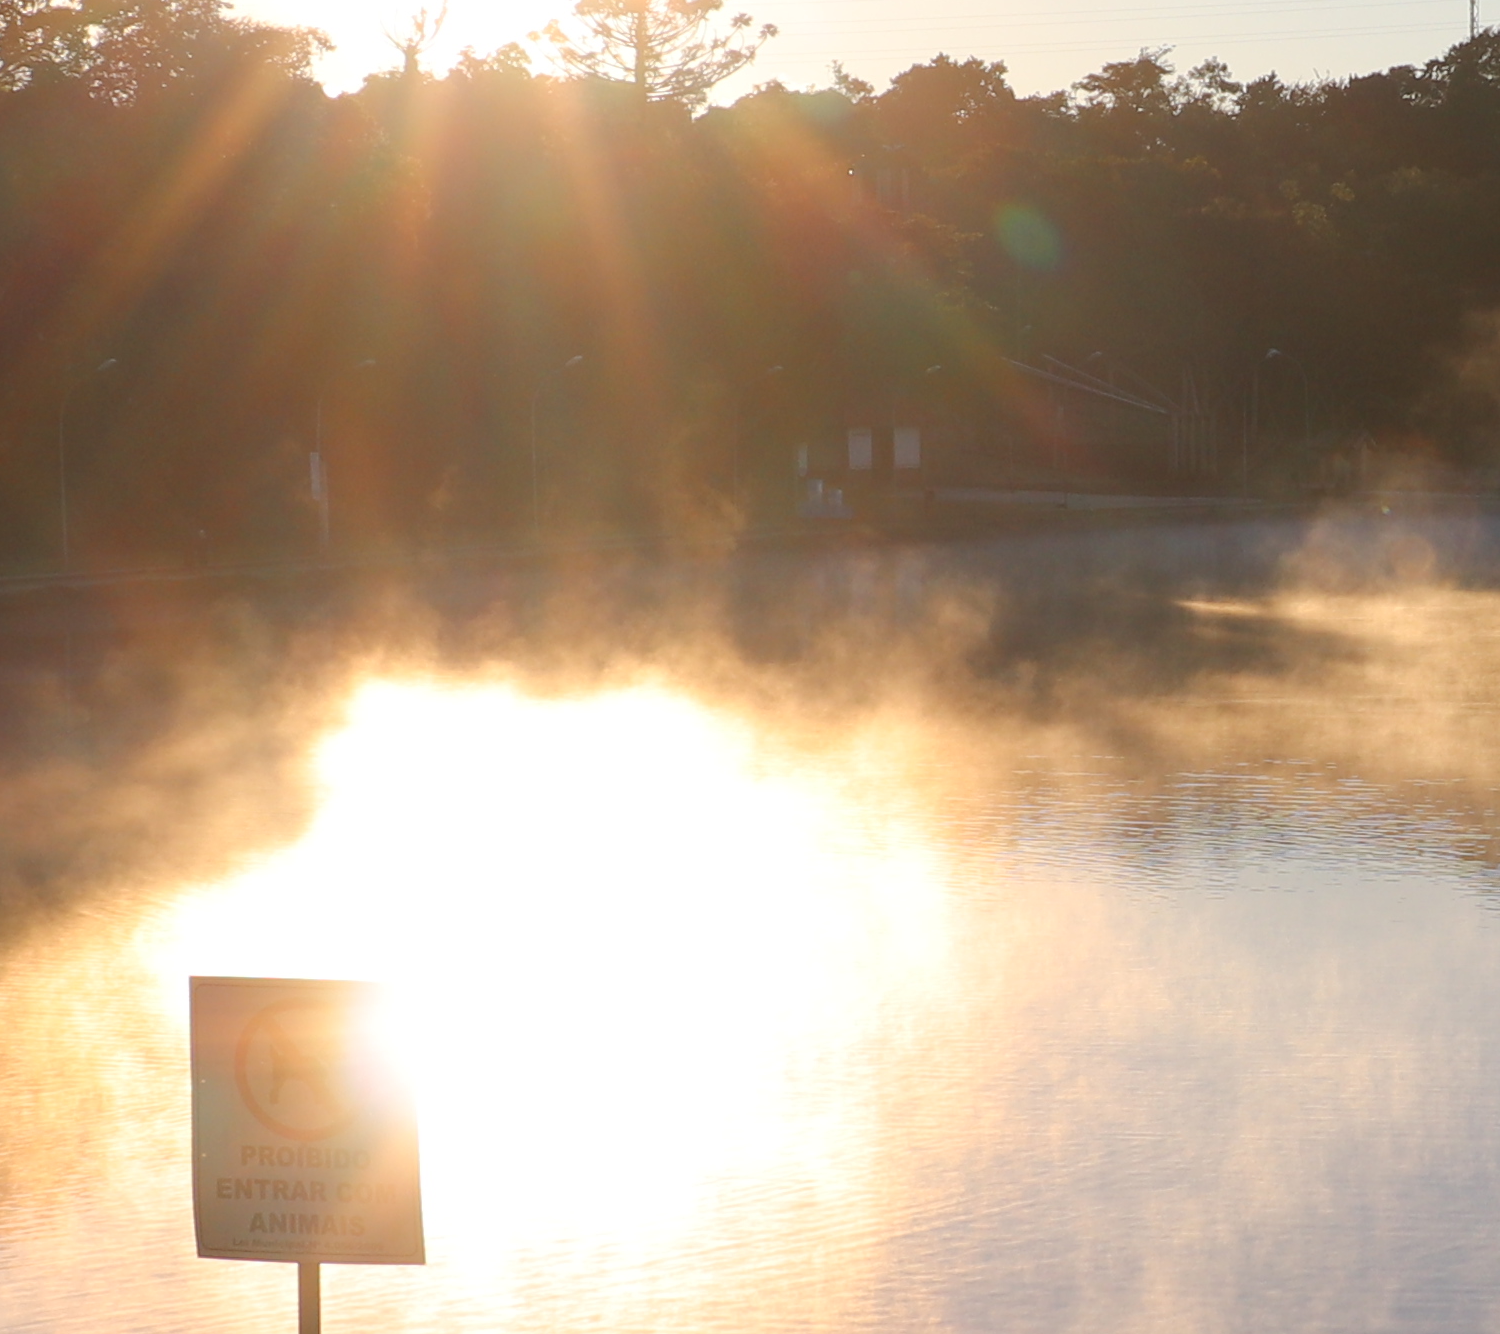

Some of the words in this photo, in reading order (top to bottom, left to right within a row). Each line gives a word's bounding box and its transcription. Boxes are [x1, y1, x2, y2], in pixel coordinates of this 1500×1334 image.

[240, 1144, 371, 1170] PROIBIDO
[216, 1177, 327, 1202] ENTRAR
[336, 1181, 398, 1205] COM
[248, 1212, 366, 1237] ANIMAIS
